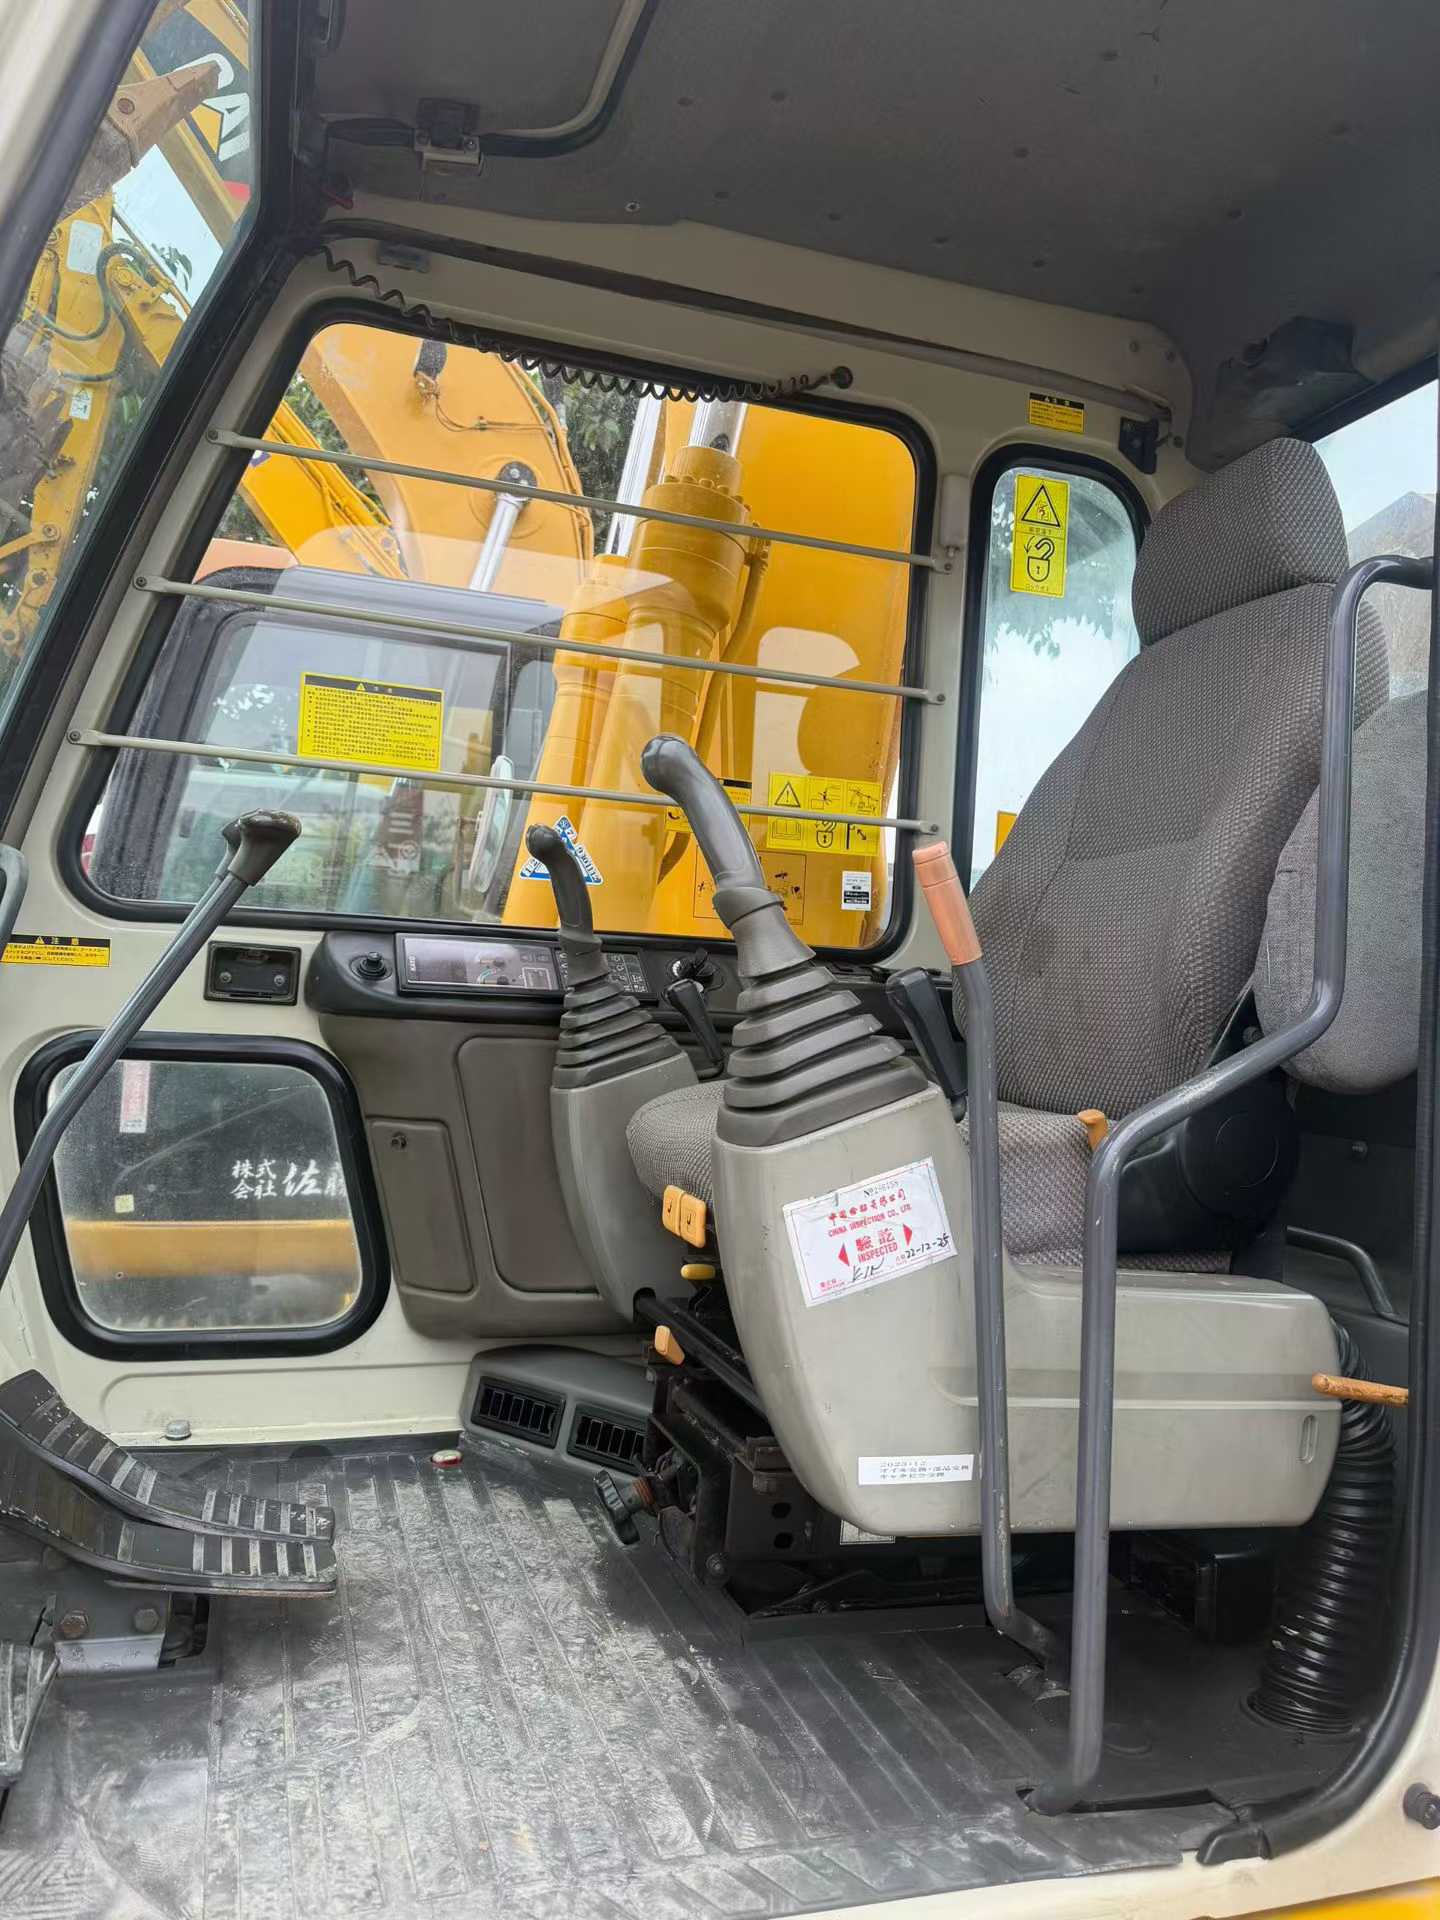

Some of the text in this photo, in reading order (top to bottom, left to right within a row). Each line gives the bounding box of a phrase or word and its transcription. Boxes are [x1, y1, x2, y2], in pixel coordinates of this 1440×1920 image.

[231, 1158, 277, 1179] 株式
[230, 1179, 278, 1200] 会社
[828, 1224, 847, 1238] CHINA
[850, 1214, 886, 1231] INSPECTION
[857, 1242, 898, 1263] INSPECTED
